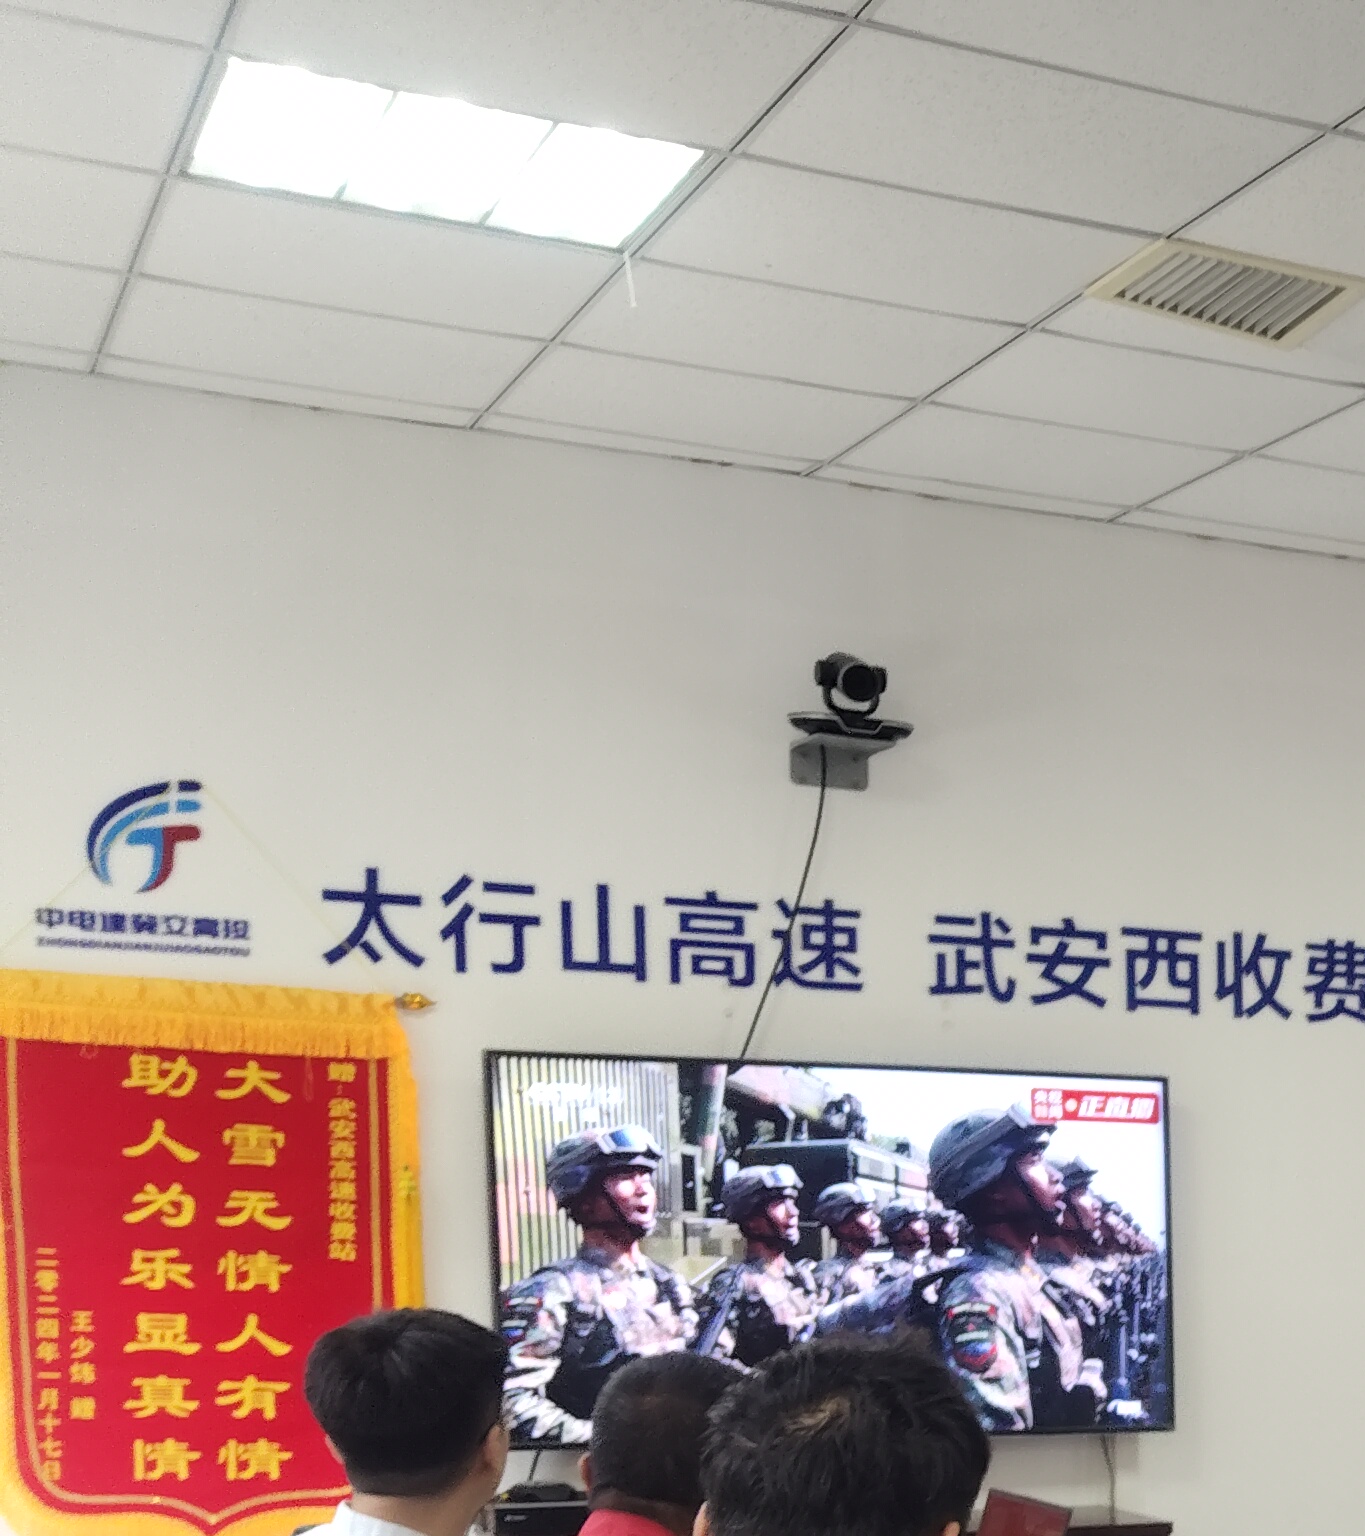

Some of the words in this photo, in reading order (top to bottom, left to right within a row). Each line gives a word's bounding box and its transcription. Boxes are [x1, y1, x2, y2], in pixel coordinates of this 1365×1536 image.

[320, 866, 865, 993] 太行山高速
[121, 1053, 202, 1483] 助人为乐显真情
[214, 1057, 294, 1483] 大雪无情人有情
